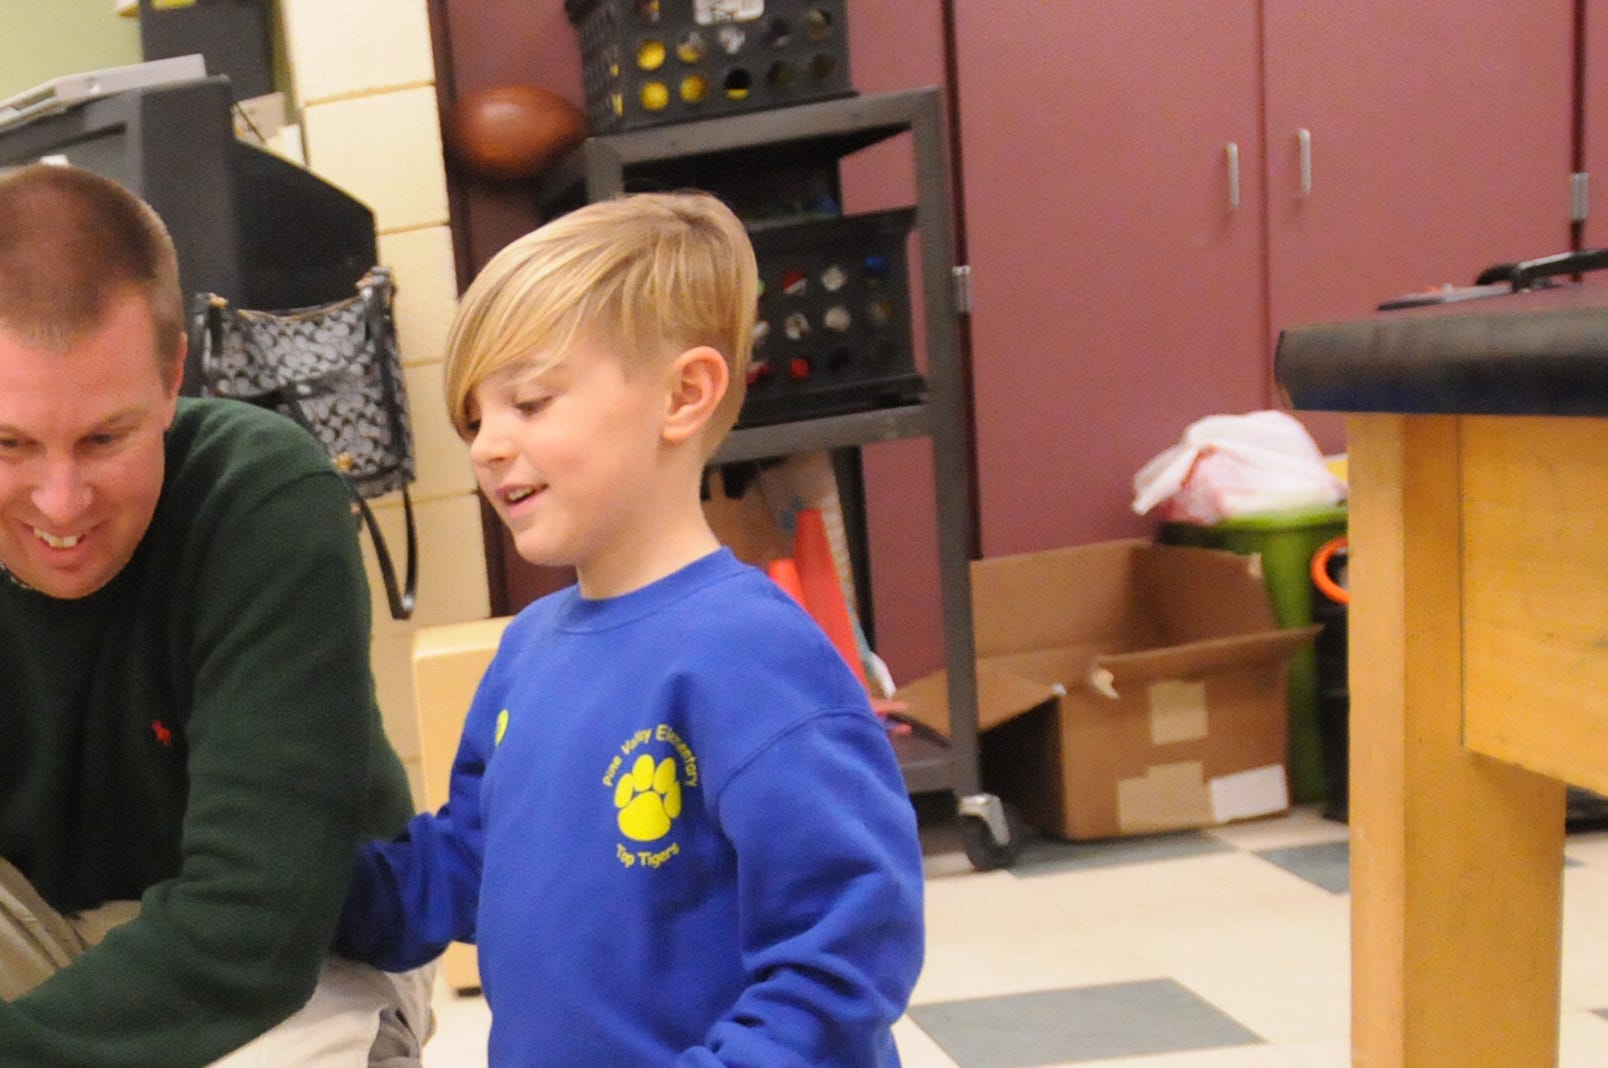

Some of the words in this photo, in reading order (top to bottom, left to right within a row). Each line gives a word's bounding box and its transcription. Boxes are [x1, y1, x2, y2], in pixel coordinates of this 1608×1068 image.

[602, 755, 623, 787] Pine
[616, 843, 636, 868] Top
[637, 842, 681, 868] Tigers
